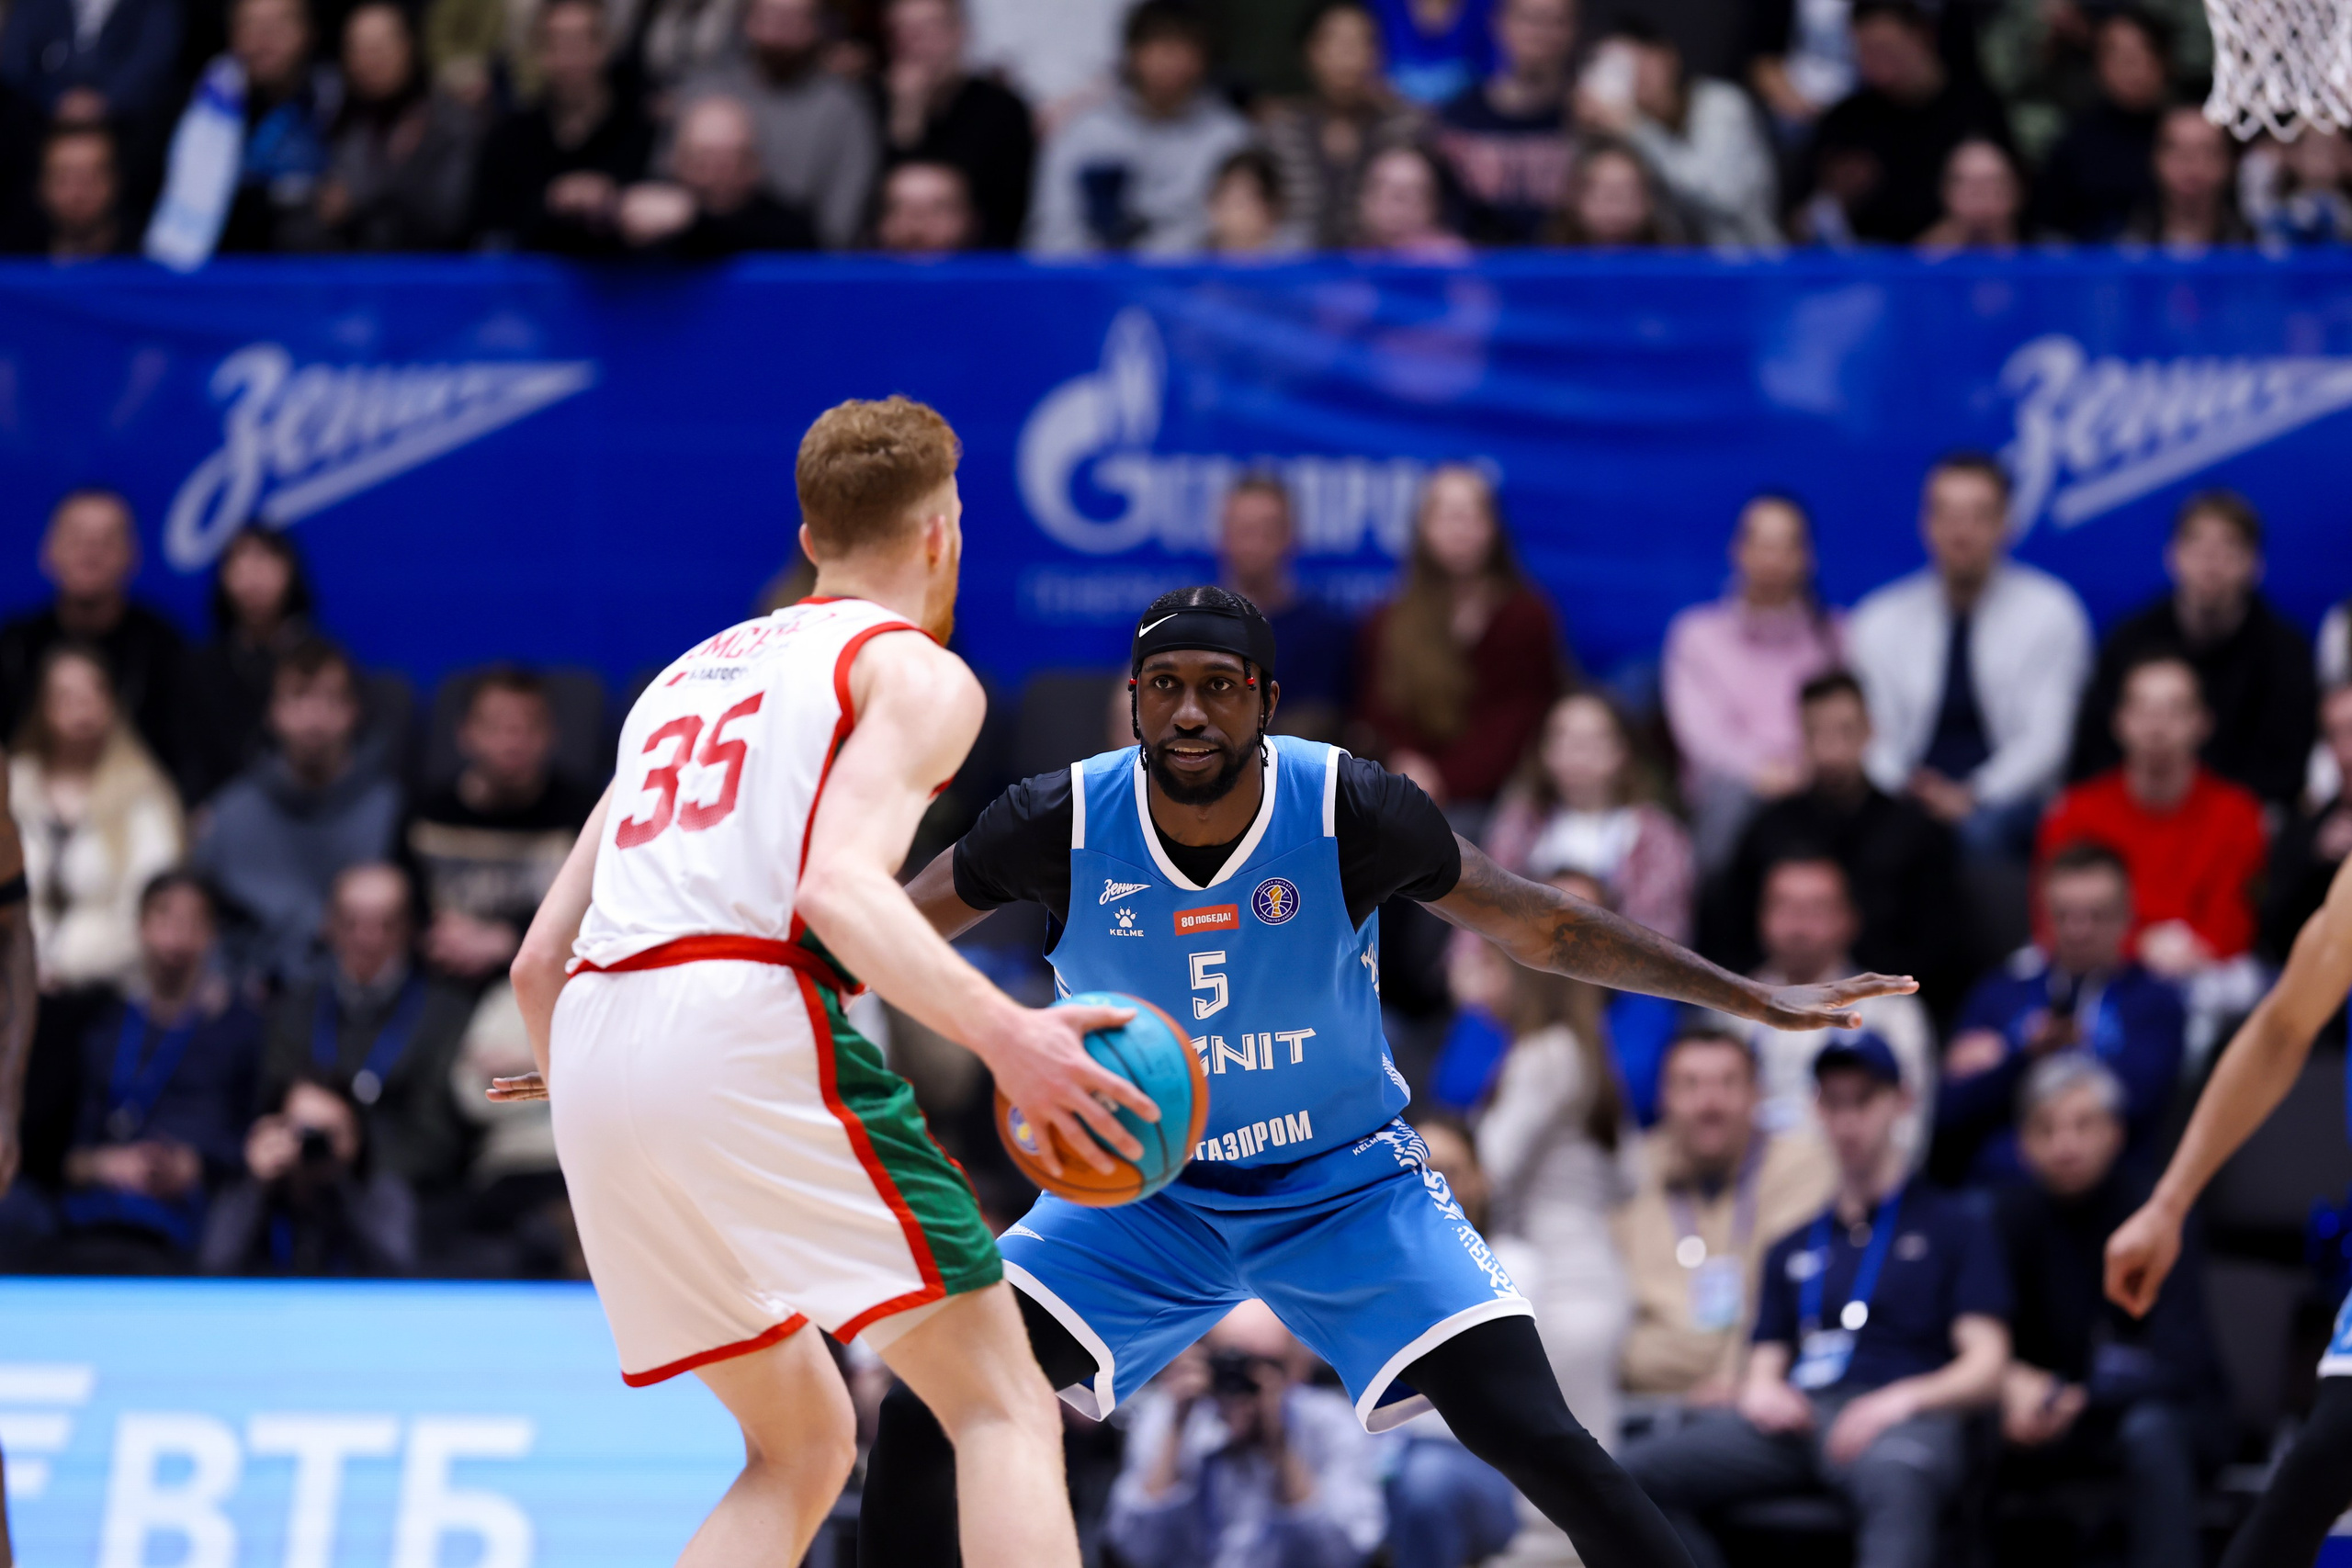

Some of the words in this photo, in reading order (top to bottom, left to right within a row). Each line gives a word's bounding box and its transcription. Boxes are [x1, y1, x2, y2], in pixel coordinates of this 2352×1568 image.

[616, 690, 765, 851] 35
[1109, 928, 1145, 937] KELME
[1181, 916, 1194, 928] 80
[1195, 912, 1232, 924] ПОБЕДА!
[1188, 950, 1229, 1021] 5
[1195, 1110, 1313, 1161] ГАЗПРОМ
[97, 1410, 535, 1568] ВТБ
